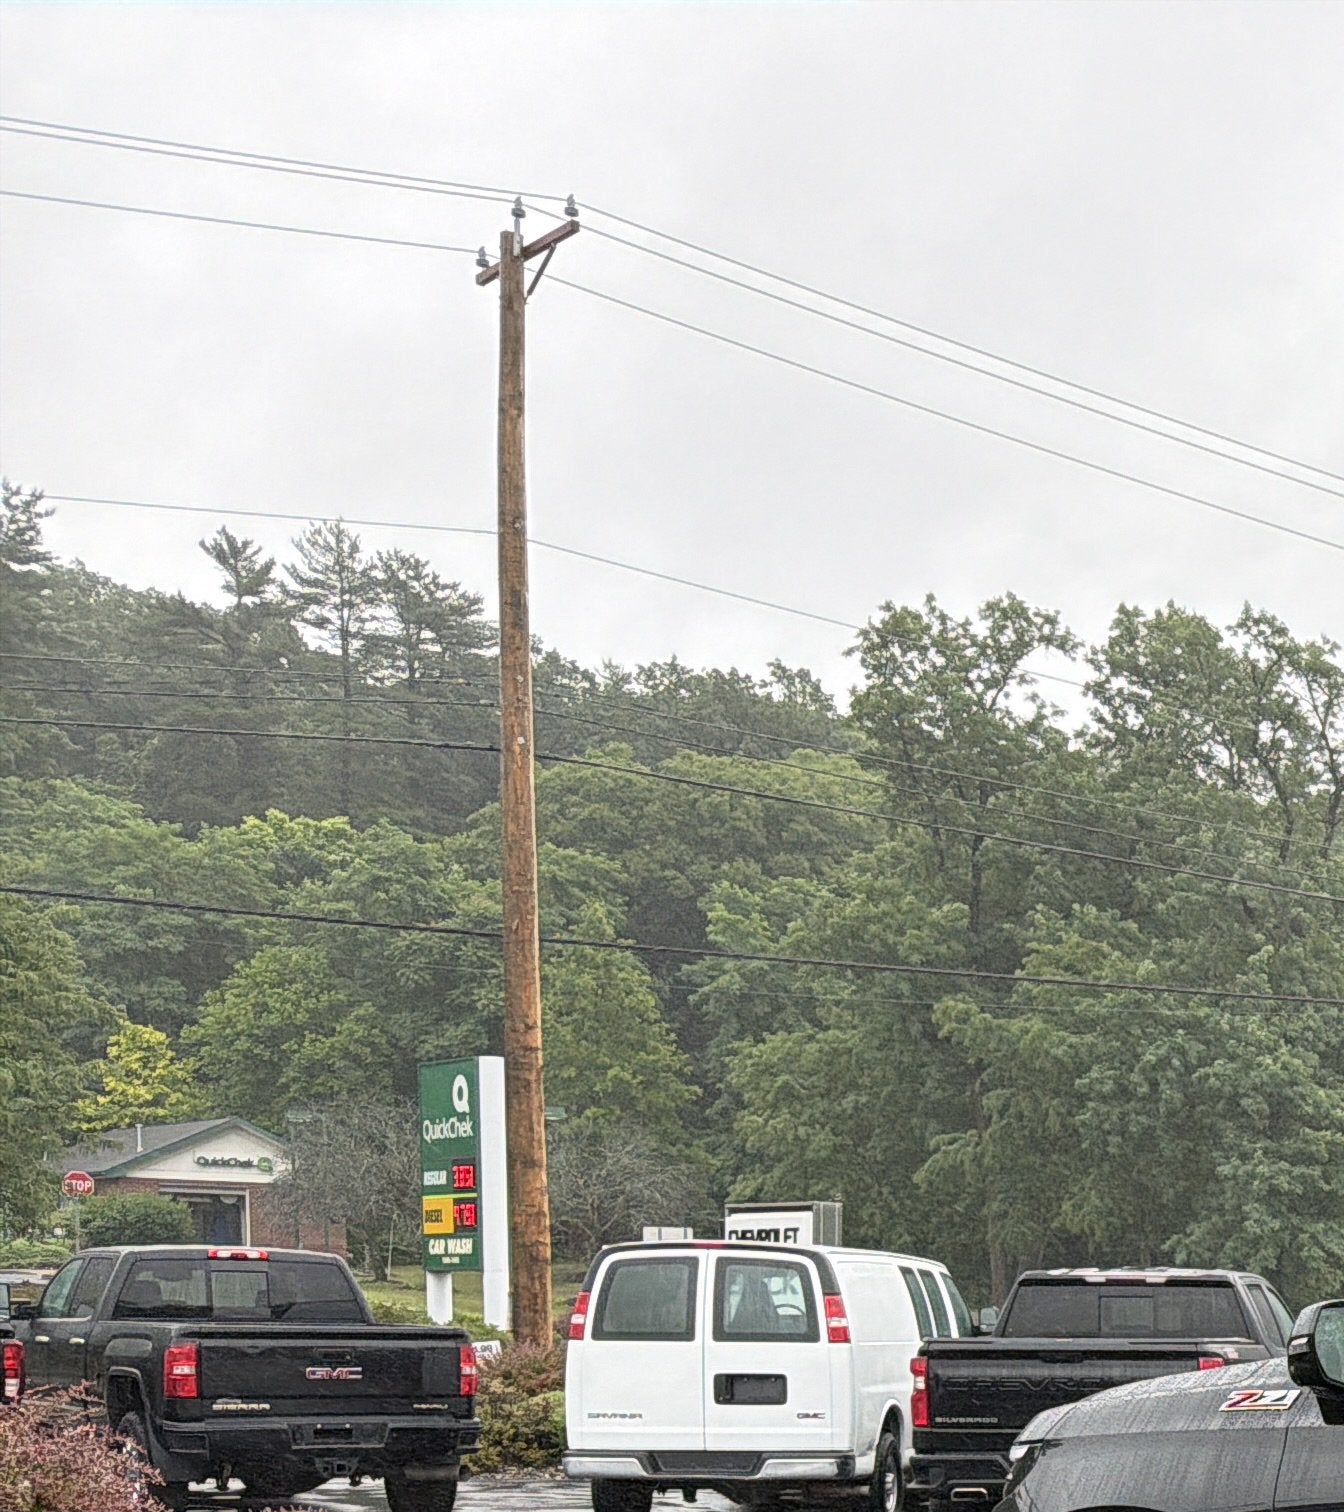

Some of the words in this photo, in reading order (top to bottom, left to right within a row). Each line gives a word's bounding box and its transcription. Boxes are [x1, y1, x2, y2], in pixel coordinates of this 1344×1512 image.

[452, 1074, 470, 1114] Q
[423, 1115, 473, 1143] QuickChek
[196, 1156, 255, 1169] QuickChek
[64, 1179, 92, 1192] STOP
[428, 1238, 446, 1256] CAR
[447, 1237, 473, 1255] WASH
[305, 1366, 363, 1380] GMC
[1218, 1389, 1302, 1411] Z71
[796, 1412, 826, 1420] GMC
[935, 1416, 999, 1424] SILVERADO
